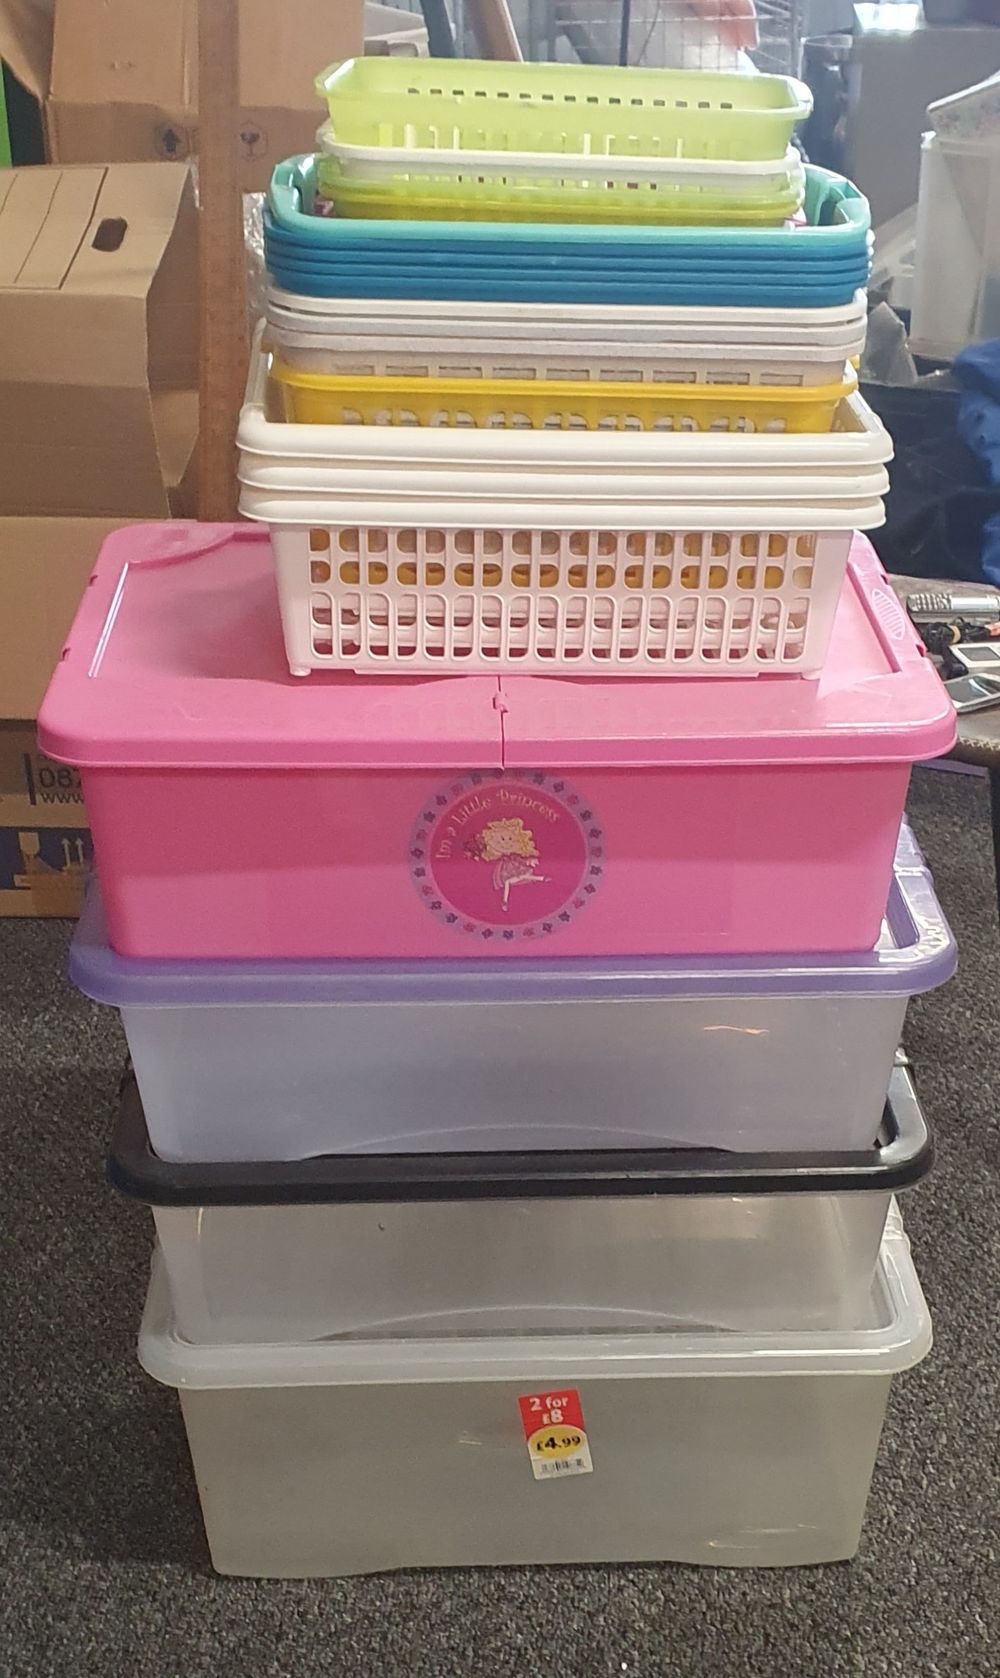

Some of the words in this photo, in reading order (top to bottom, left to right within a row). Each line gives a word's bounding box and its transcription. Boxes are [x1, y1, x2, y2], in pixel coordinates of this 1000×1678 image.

[451, 796, 490, 825] Little
[496, 789, 559, 821] Princess
[529, 1397, 542, 1411] 2
[545, 1396, 568, 1409] for
[542, 1408, 564, 1425] £8
[536, 1436, 581, 1451] £4.99
